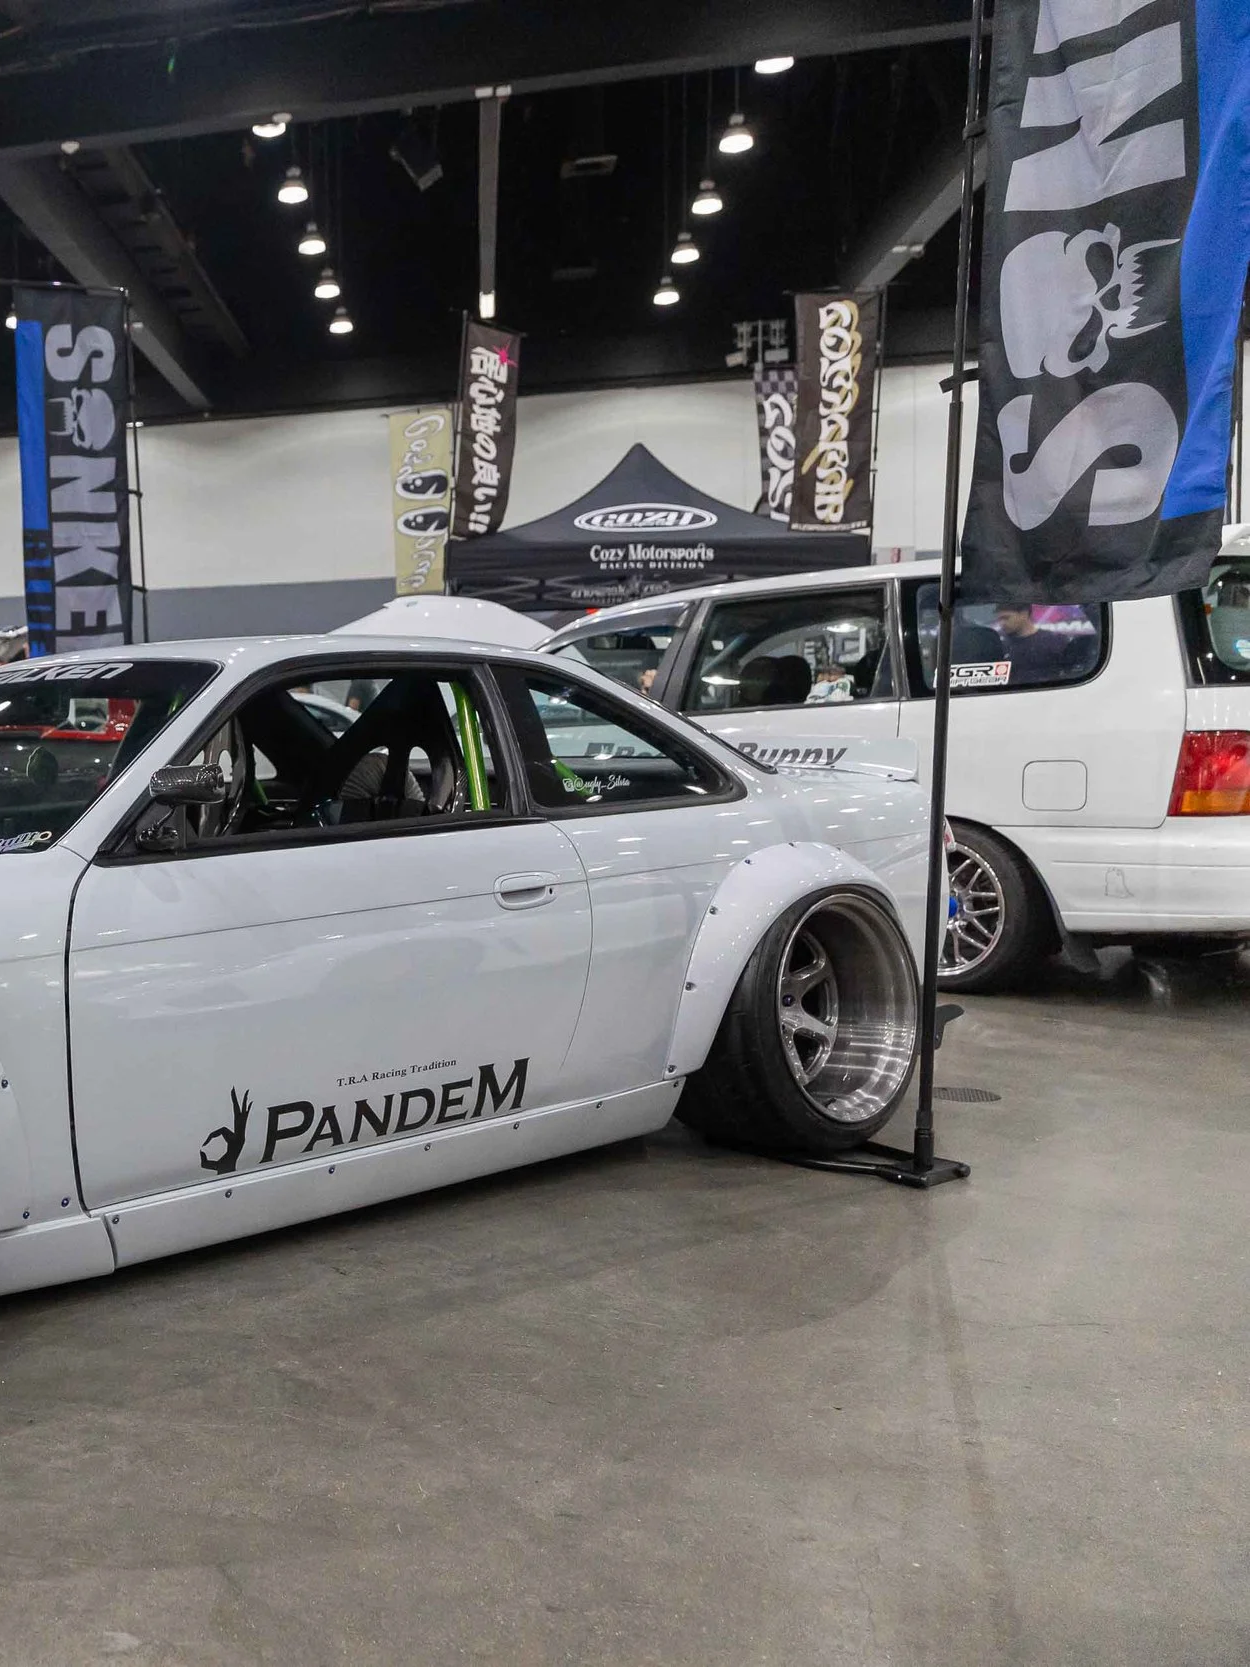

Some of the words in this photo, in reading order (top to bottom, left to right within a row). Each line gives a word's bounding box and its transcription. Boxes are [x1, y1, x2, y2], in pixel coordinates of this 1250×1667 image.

[590, 544, 626, 562] Cozy
[628, 543, 715, 562] Motorsports
[737, 742, 848, 767] Bunny
[337, 1074, 368, 1087] T.R.A
[372, 1066, 407, 1081] Racing
[410, 1058, 458, 1075] Tradition
